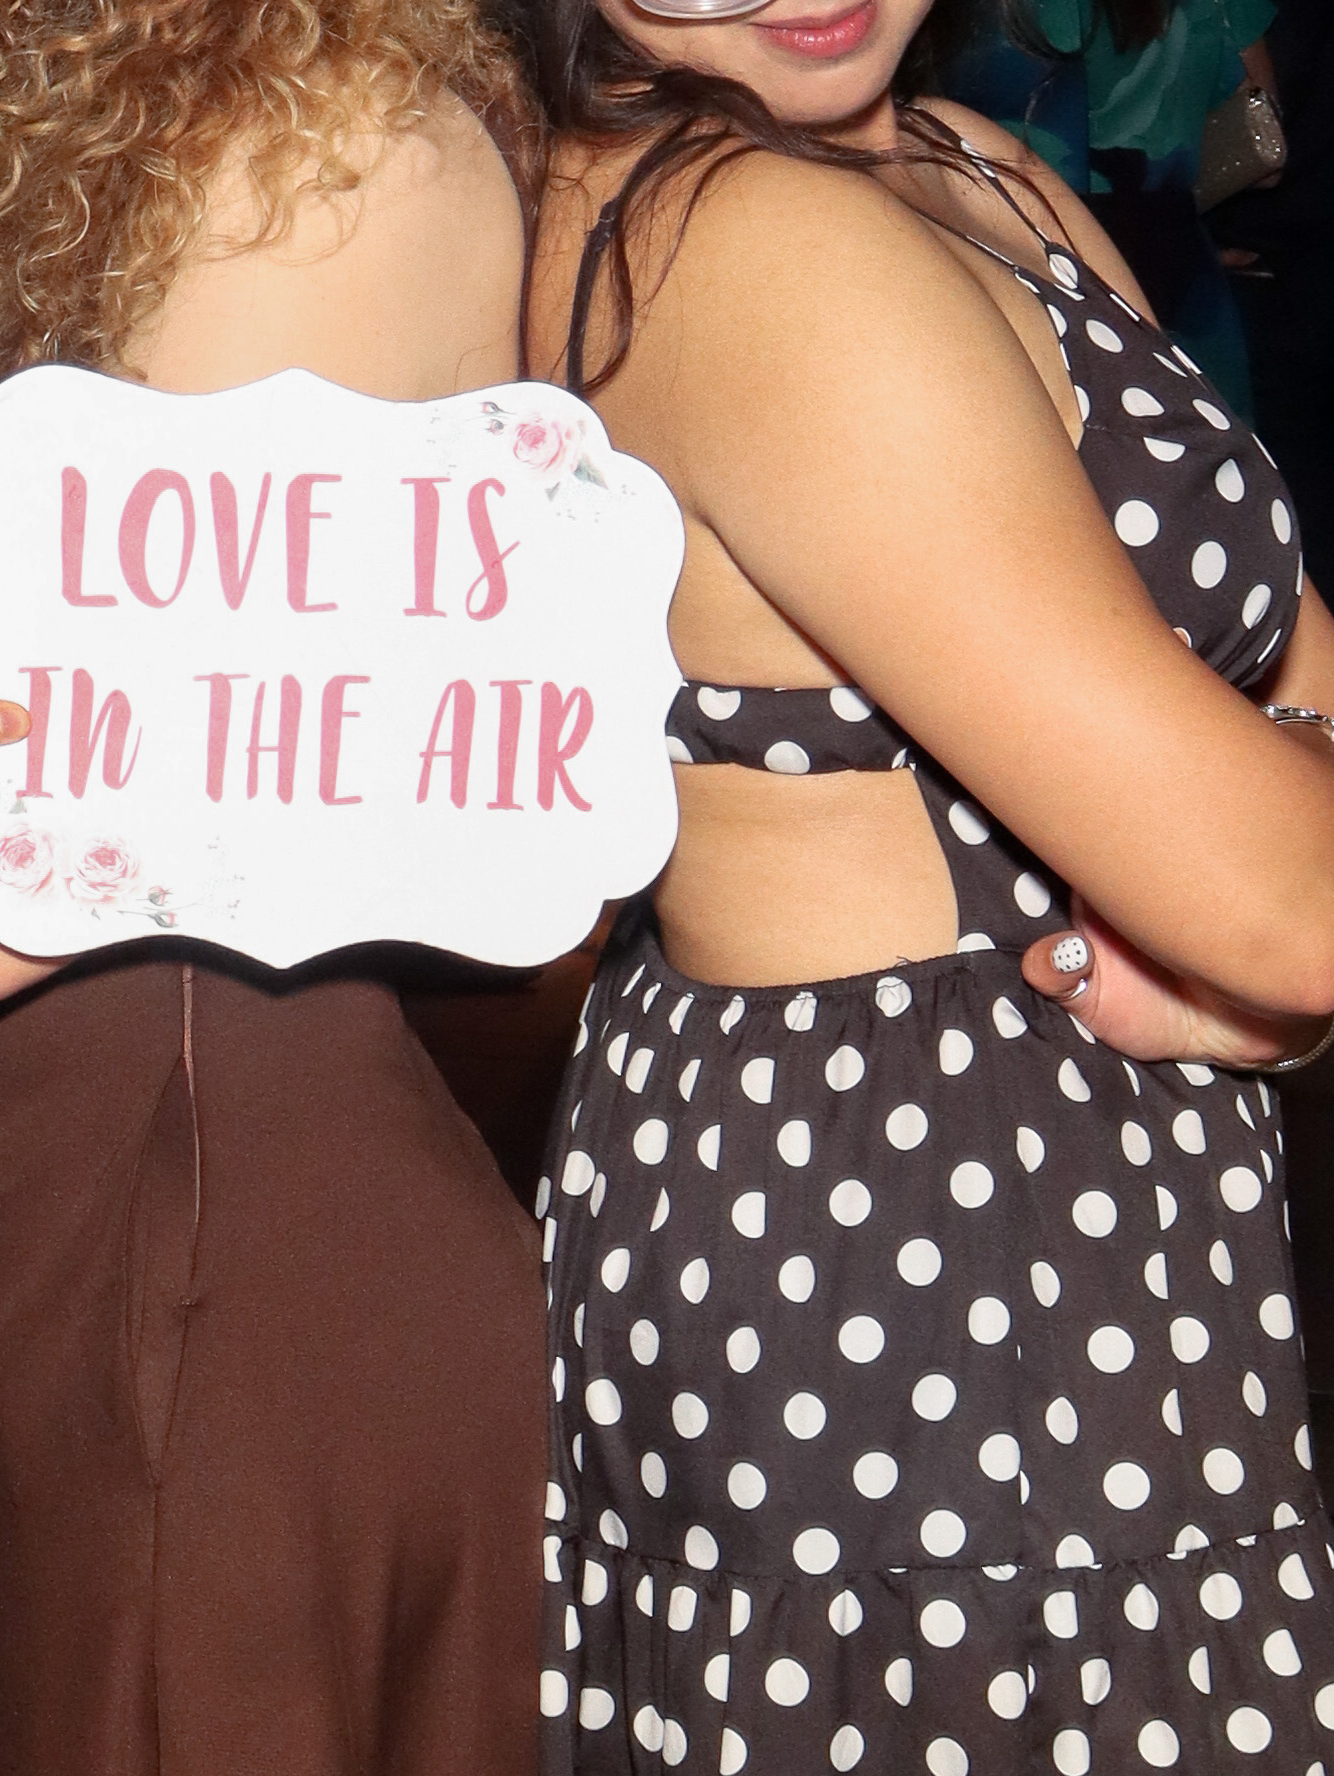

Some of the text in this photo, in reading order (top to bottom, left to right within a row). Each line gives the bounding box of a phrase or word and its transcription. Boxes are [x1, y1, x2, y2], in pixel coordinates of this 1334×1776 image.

[60, 465, 521, 621] LOVE IS
[193, 671, 373, 806] THE
[415, 678, 596, 813] AIR
